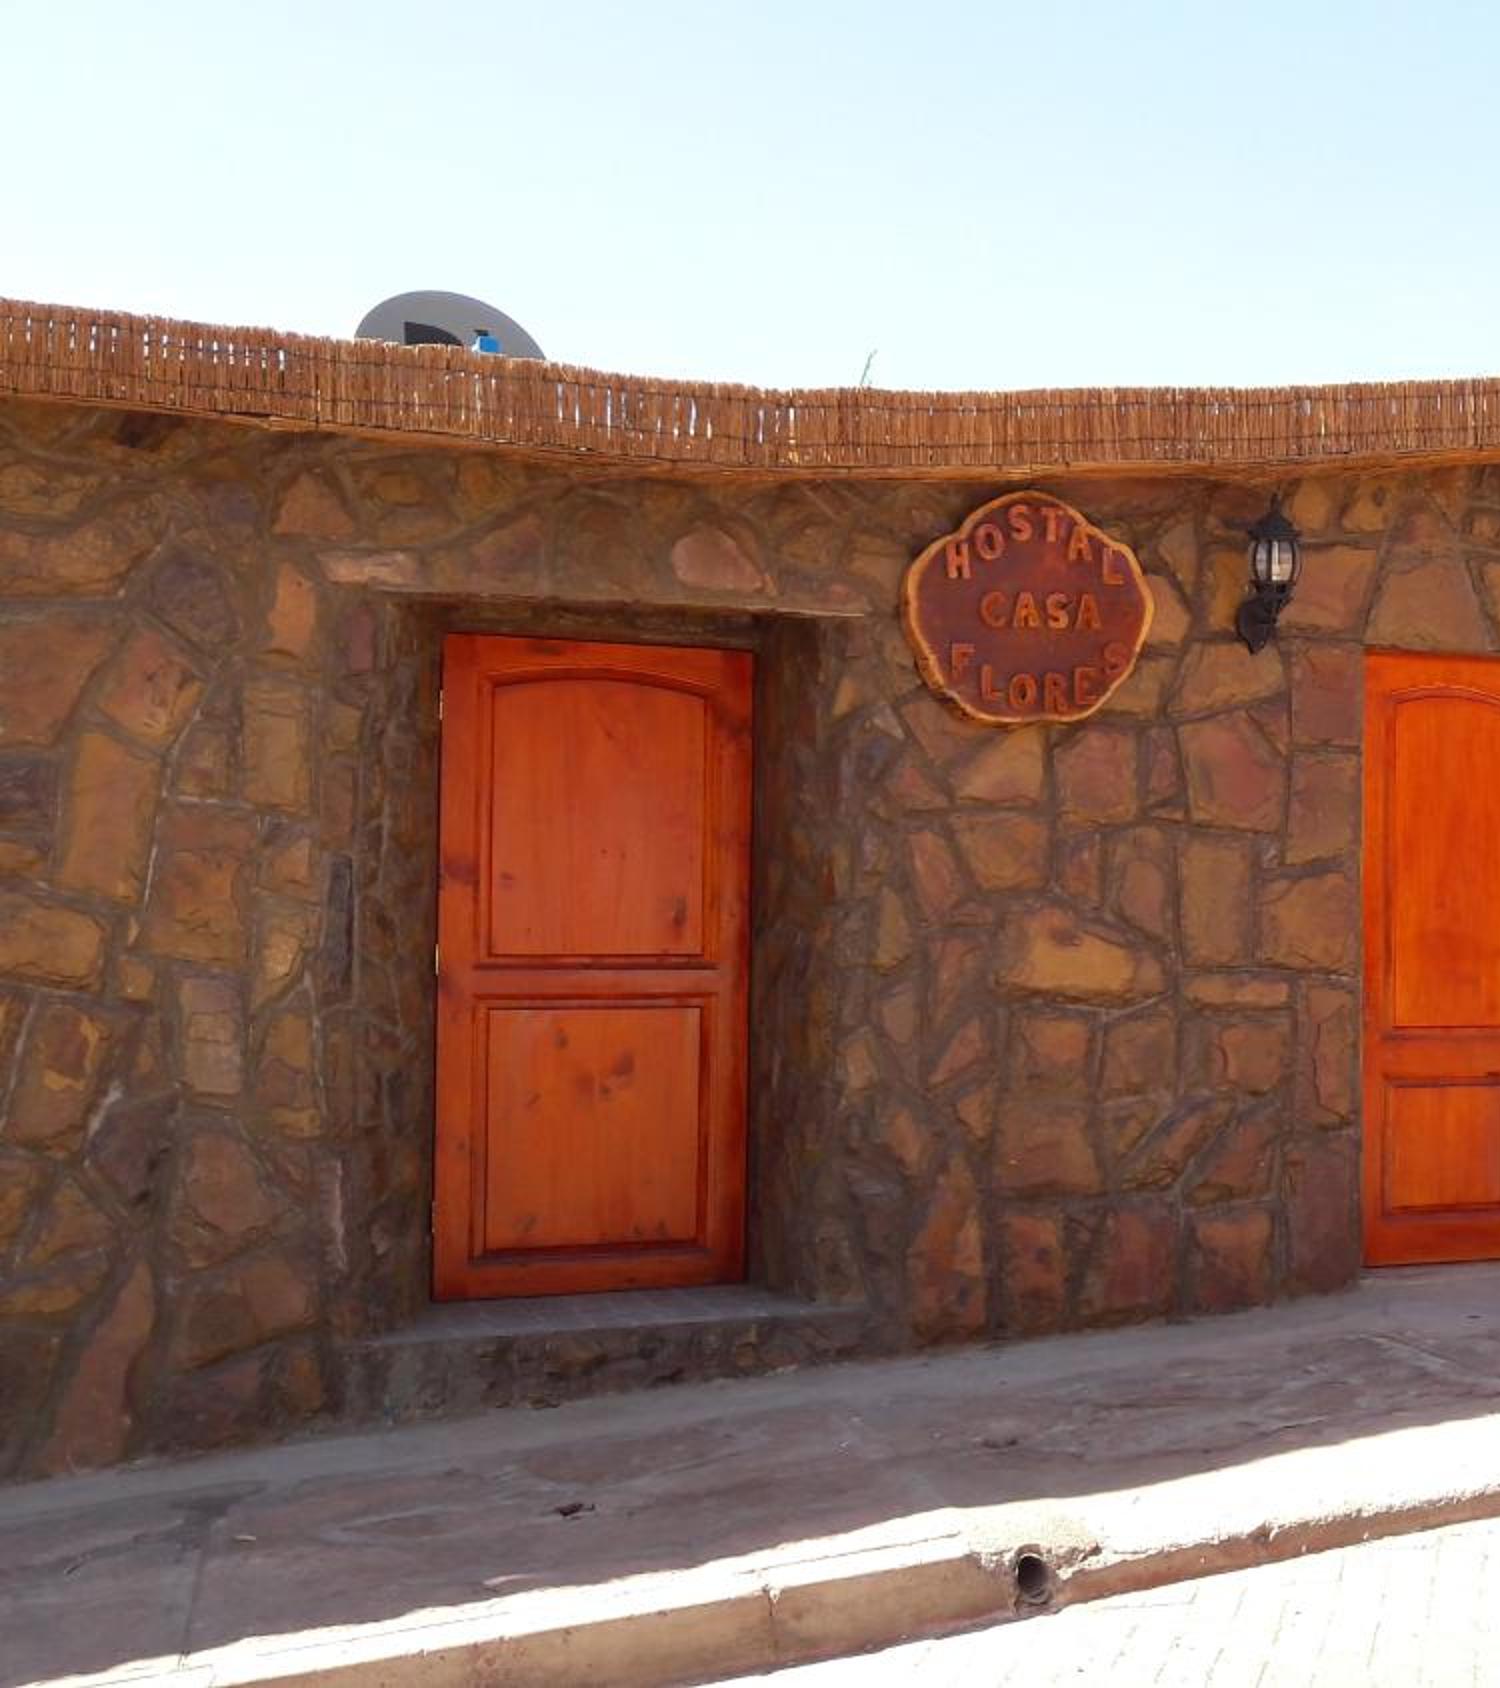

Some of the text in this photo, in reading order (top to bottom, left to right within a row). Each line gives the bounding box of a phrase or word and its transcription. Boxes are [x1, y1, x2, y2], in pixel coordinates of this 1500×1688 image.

[946, 504, 1124, 585] HOSTAL
[980, 591, 1102, 630] CASA
[951, 642, 1130, 712] FLORES
